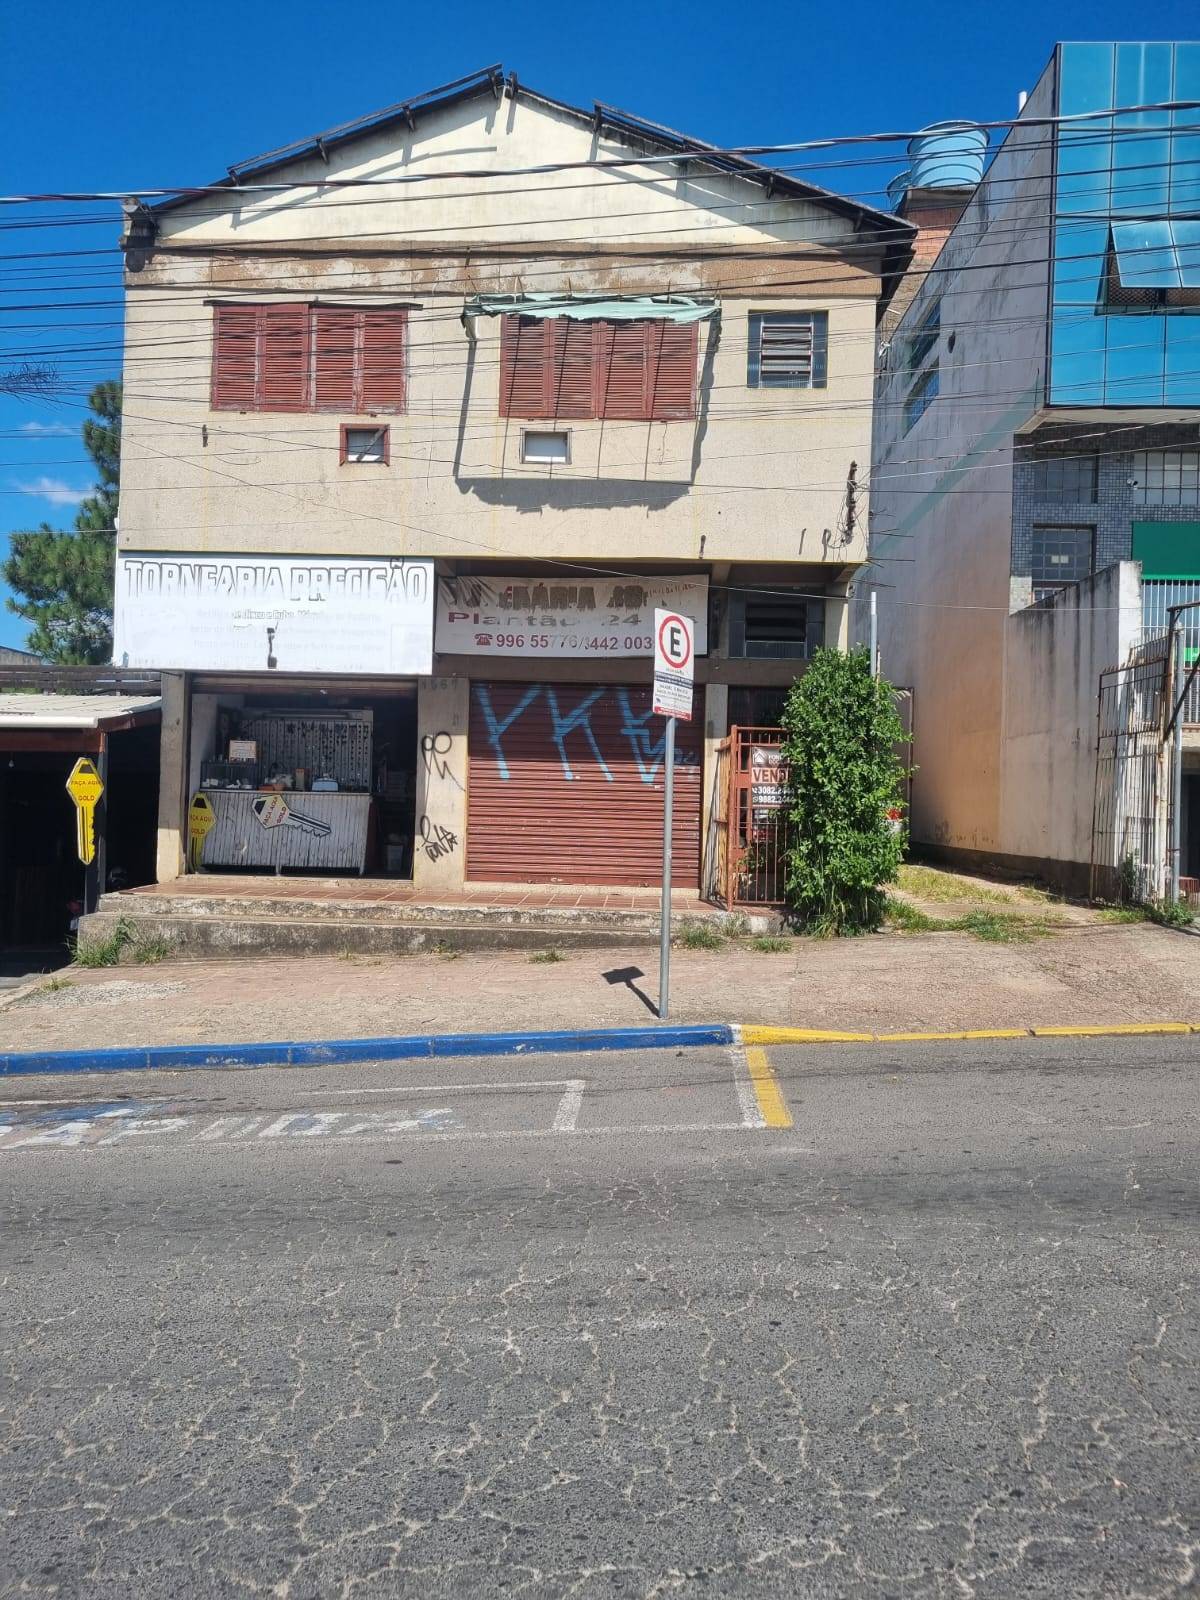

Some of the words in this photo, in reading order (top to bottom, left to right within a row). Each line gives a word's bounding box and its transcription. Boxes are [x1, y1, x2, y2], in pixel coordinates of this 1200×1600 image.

[496, 634, 524, 648] 996
[624, 636, 653, 650] 003
[670, 626, 681, 658] E
[753, 768, 791, 782] VEND
